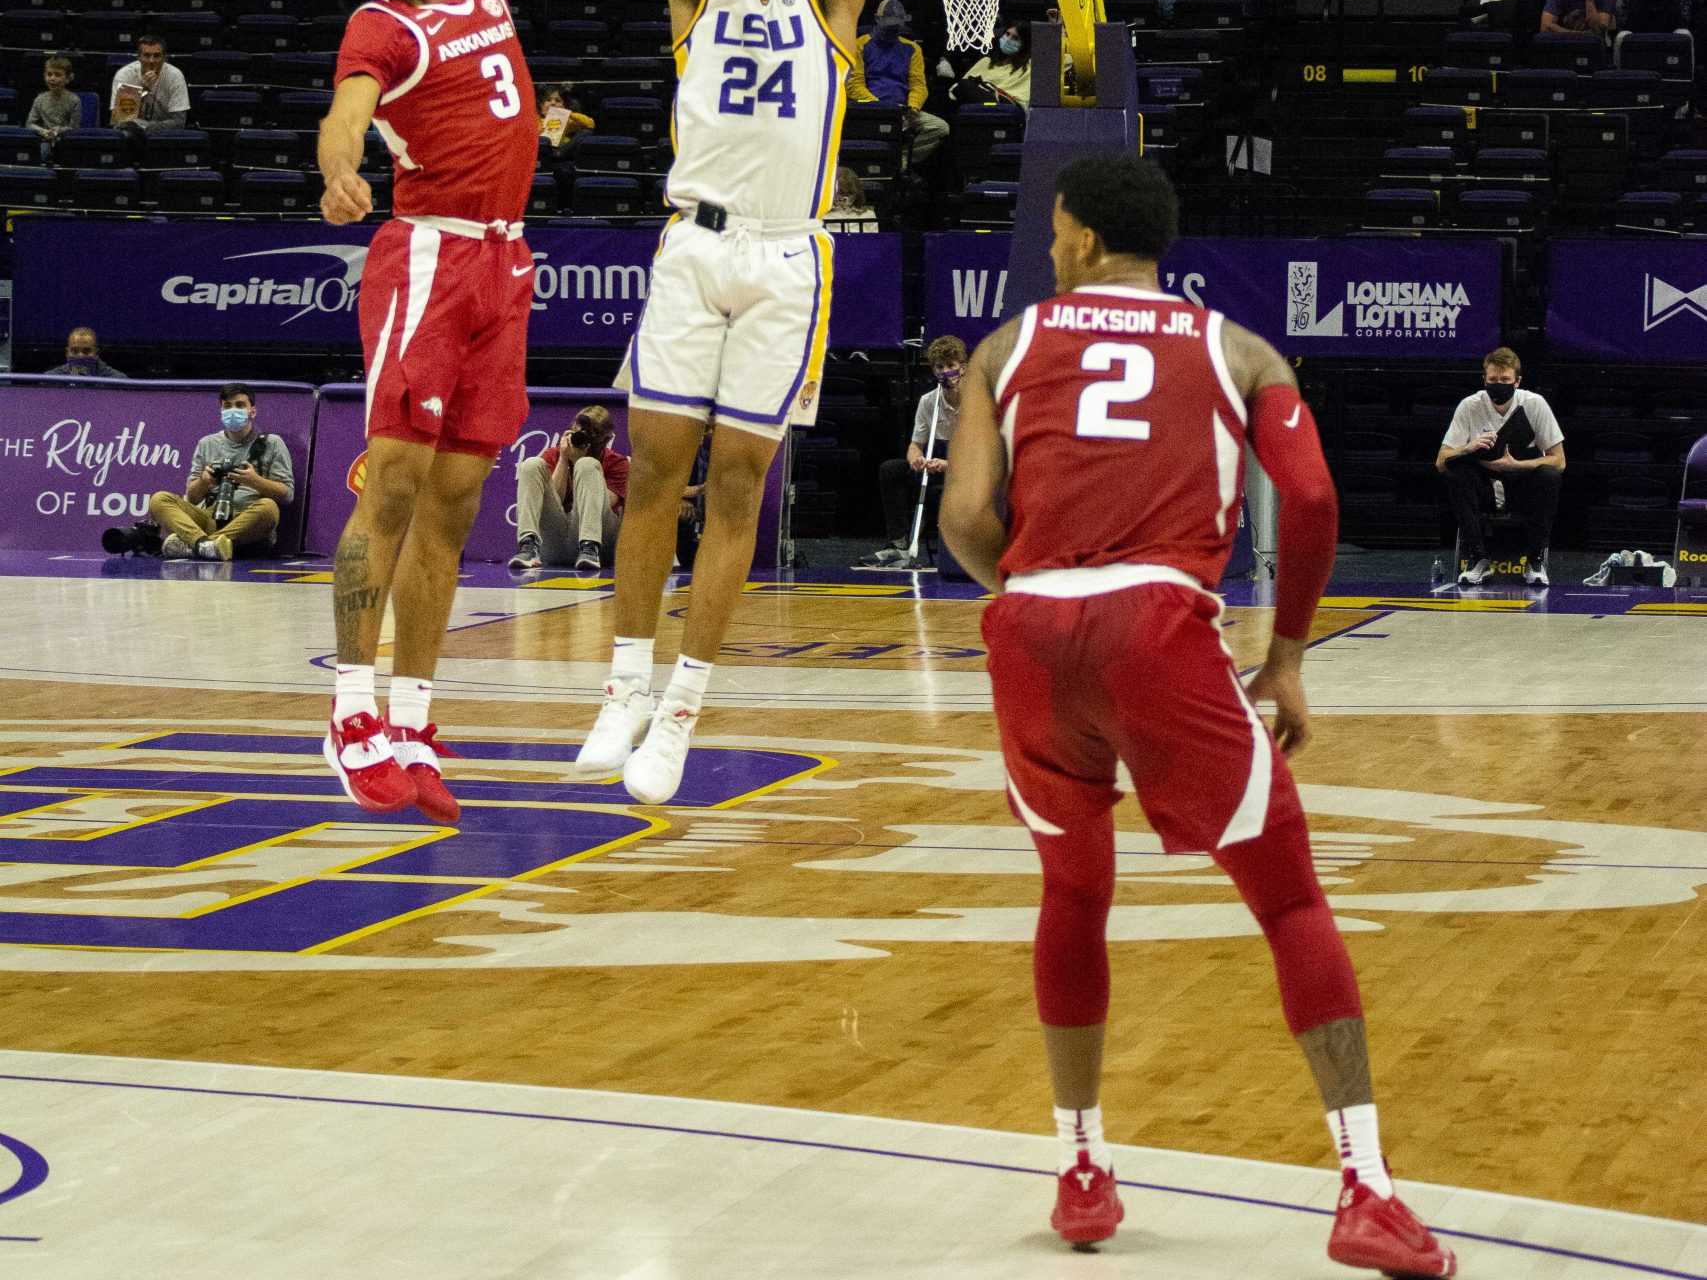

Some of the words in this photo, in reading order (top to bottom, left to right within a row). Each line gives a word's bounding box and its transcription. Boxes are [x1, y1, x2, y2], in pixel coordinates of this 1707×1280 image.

[714, 11, 805, 51] LSU
[480, 53, 521, 120] 3
[718, 56, 796, 118] 24
[1346, 281, 1471, 306] LOUISIANA
[1042, 304, 1157, 333] JACKSON
[1161, 311, 1201, 336] JR.
[1355, 304, 1461, 329] LOTTERY
[1355, 329, 1457, 338] CORPORATION
[1075, 341, 1155, 441] 2
[42, 419, 181, 486] Rhythm
[36, 491, 76, 515] OF
